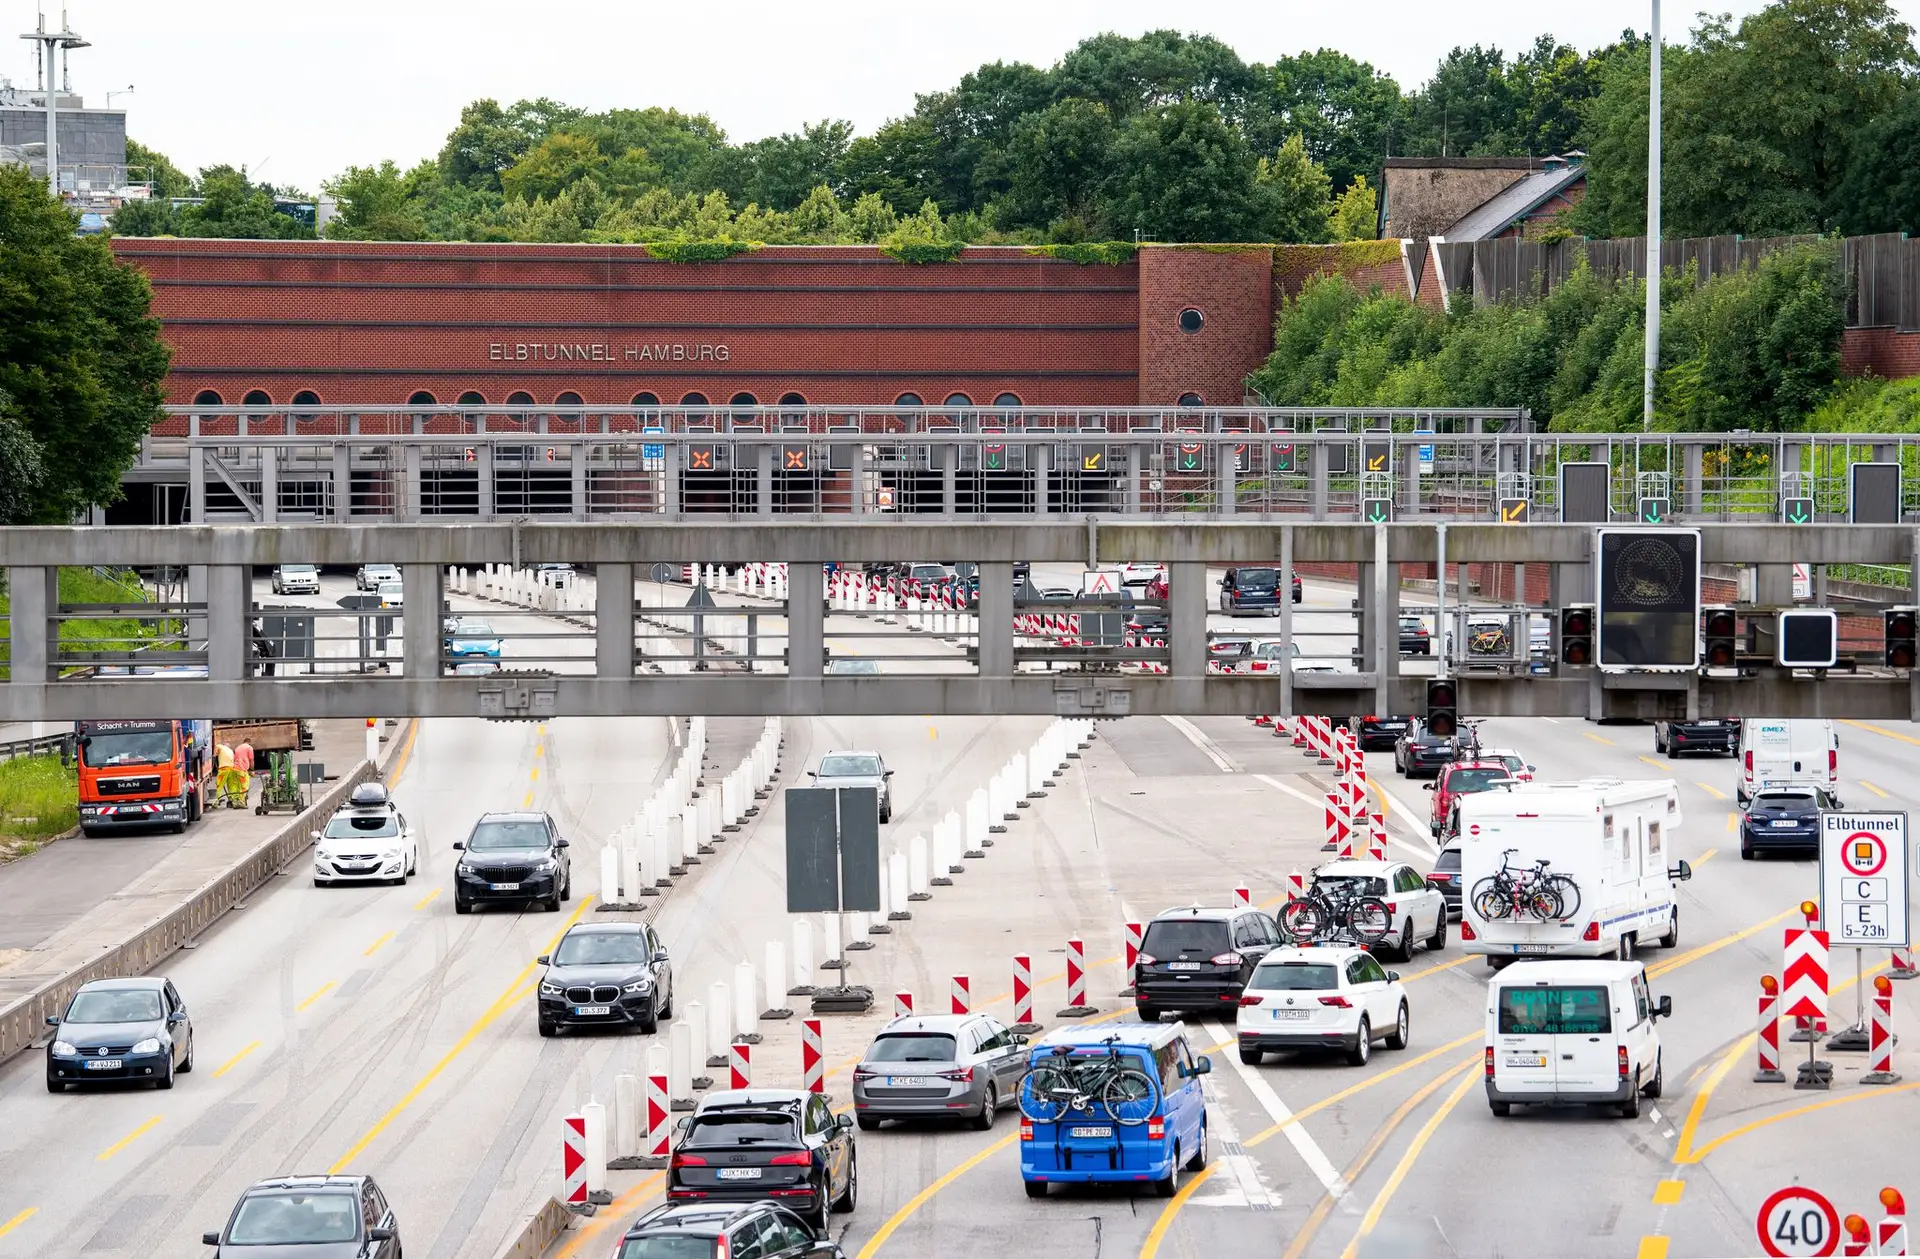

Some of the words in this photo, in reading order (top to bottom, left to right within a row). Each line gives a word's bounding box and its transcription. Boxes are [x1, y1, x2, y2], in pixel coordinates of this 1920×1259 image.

[489, 343, 616, 361] ELBTUNNEL
[624, 344, 730, 361] HAMBURG
[97, 721, 122, 731] Schacht
[130, 720, 156, 729] Trumme
[118, 781, 140, 789] MAN
[1827, 817, 1900, 831] Elbtunnel
[1858, 881, 1871, 899] C
[1859, 905, 1871, 923] E
[1845, 924, 1885, 937] 5-23h
[1095, 1128, 1111, 1136] 2022
[721, 1169, 736, 1178] CUX
[1775, 1209, 1823, 1246] 40
